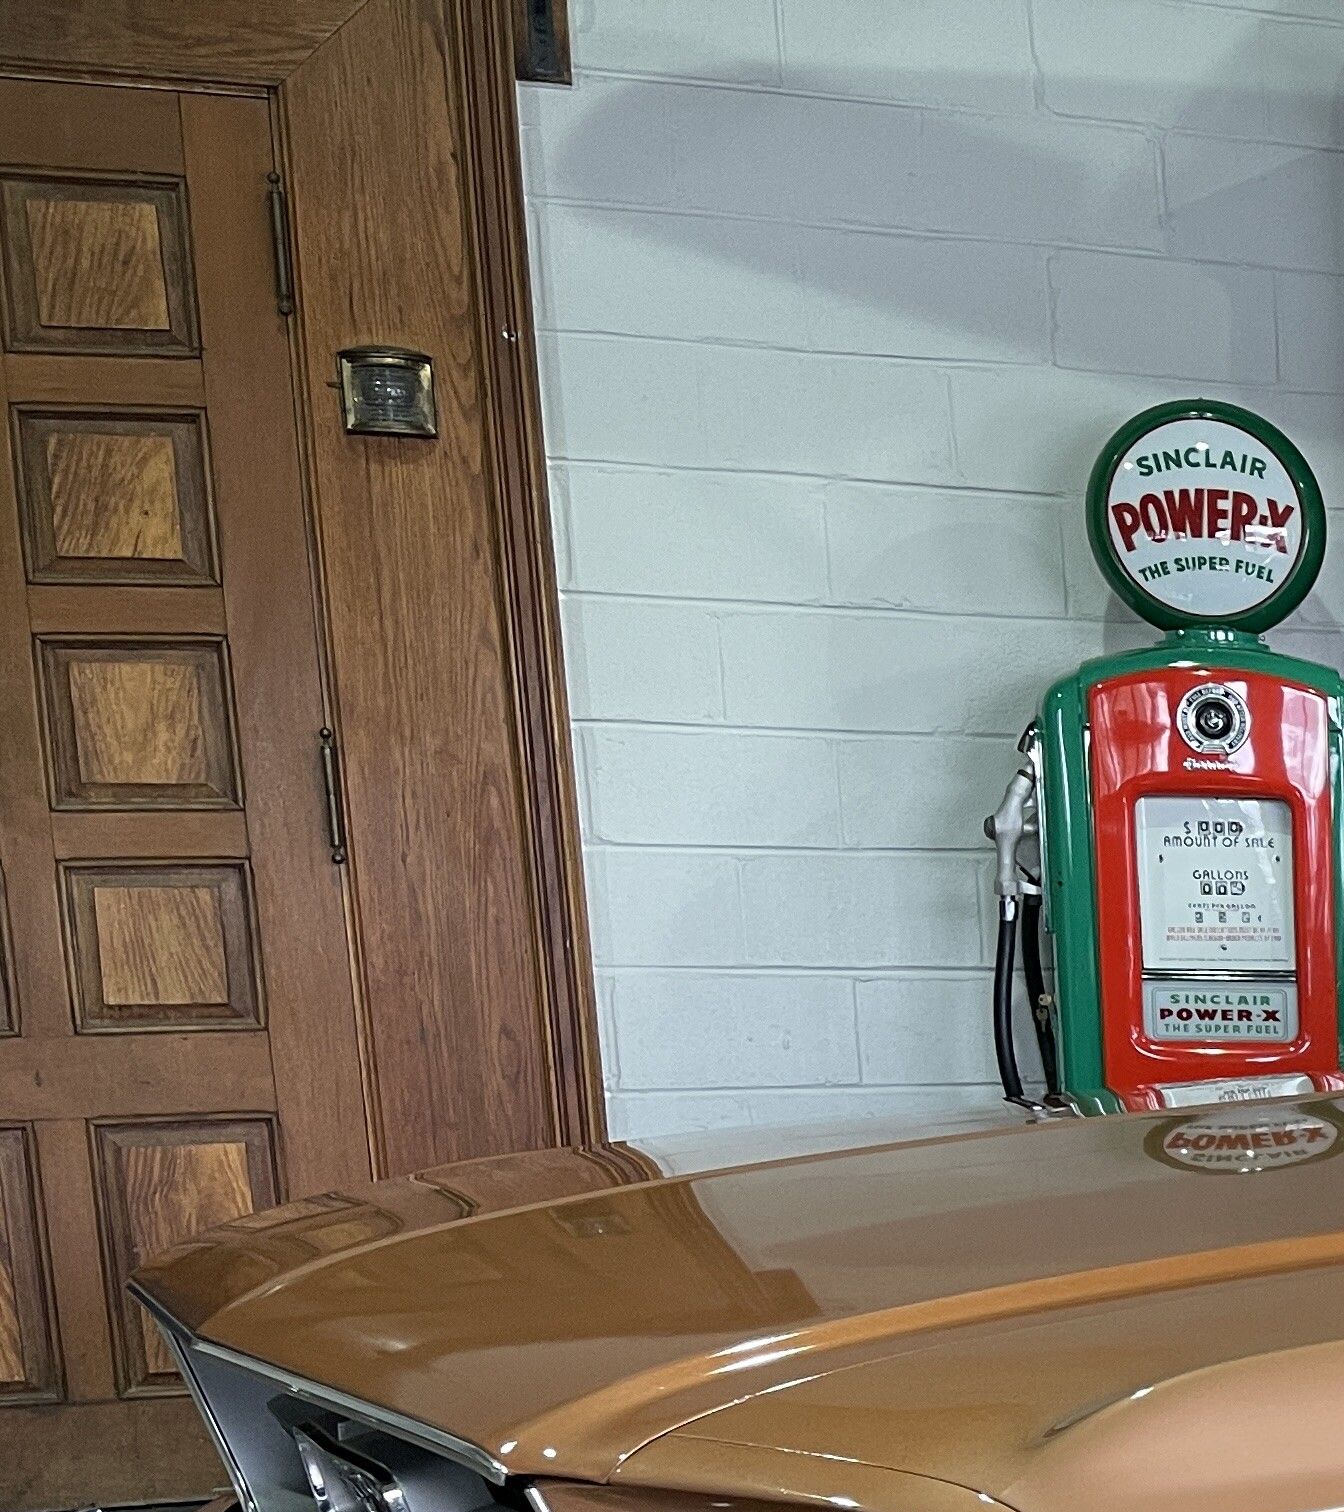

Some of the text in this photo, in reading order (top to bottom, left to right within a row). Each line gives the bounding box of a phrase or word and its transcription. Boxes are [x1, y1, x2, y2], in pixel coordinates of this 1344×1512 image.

[1136, 447, 1267, 479] SINCLAIR
[1111, 489, 1295, 554] POWER-X
[1138, 556, 1275, 584] THE SUPER FUEL
[1163, 835, 1275, 848] AMOUNT OF SALE
[1192, 869, 1249, 881] GALLONS
[1170, 993, 1272, 1007] SINCLAIR
[1159, 1007, 1281, 1023] POWER-X
[1164, 1023, 1280, 1035] THE SUPER FUEL
